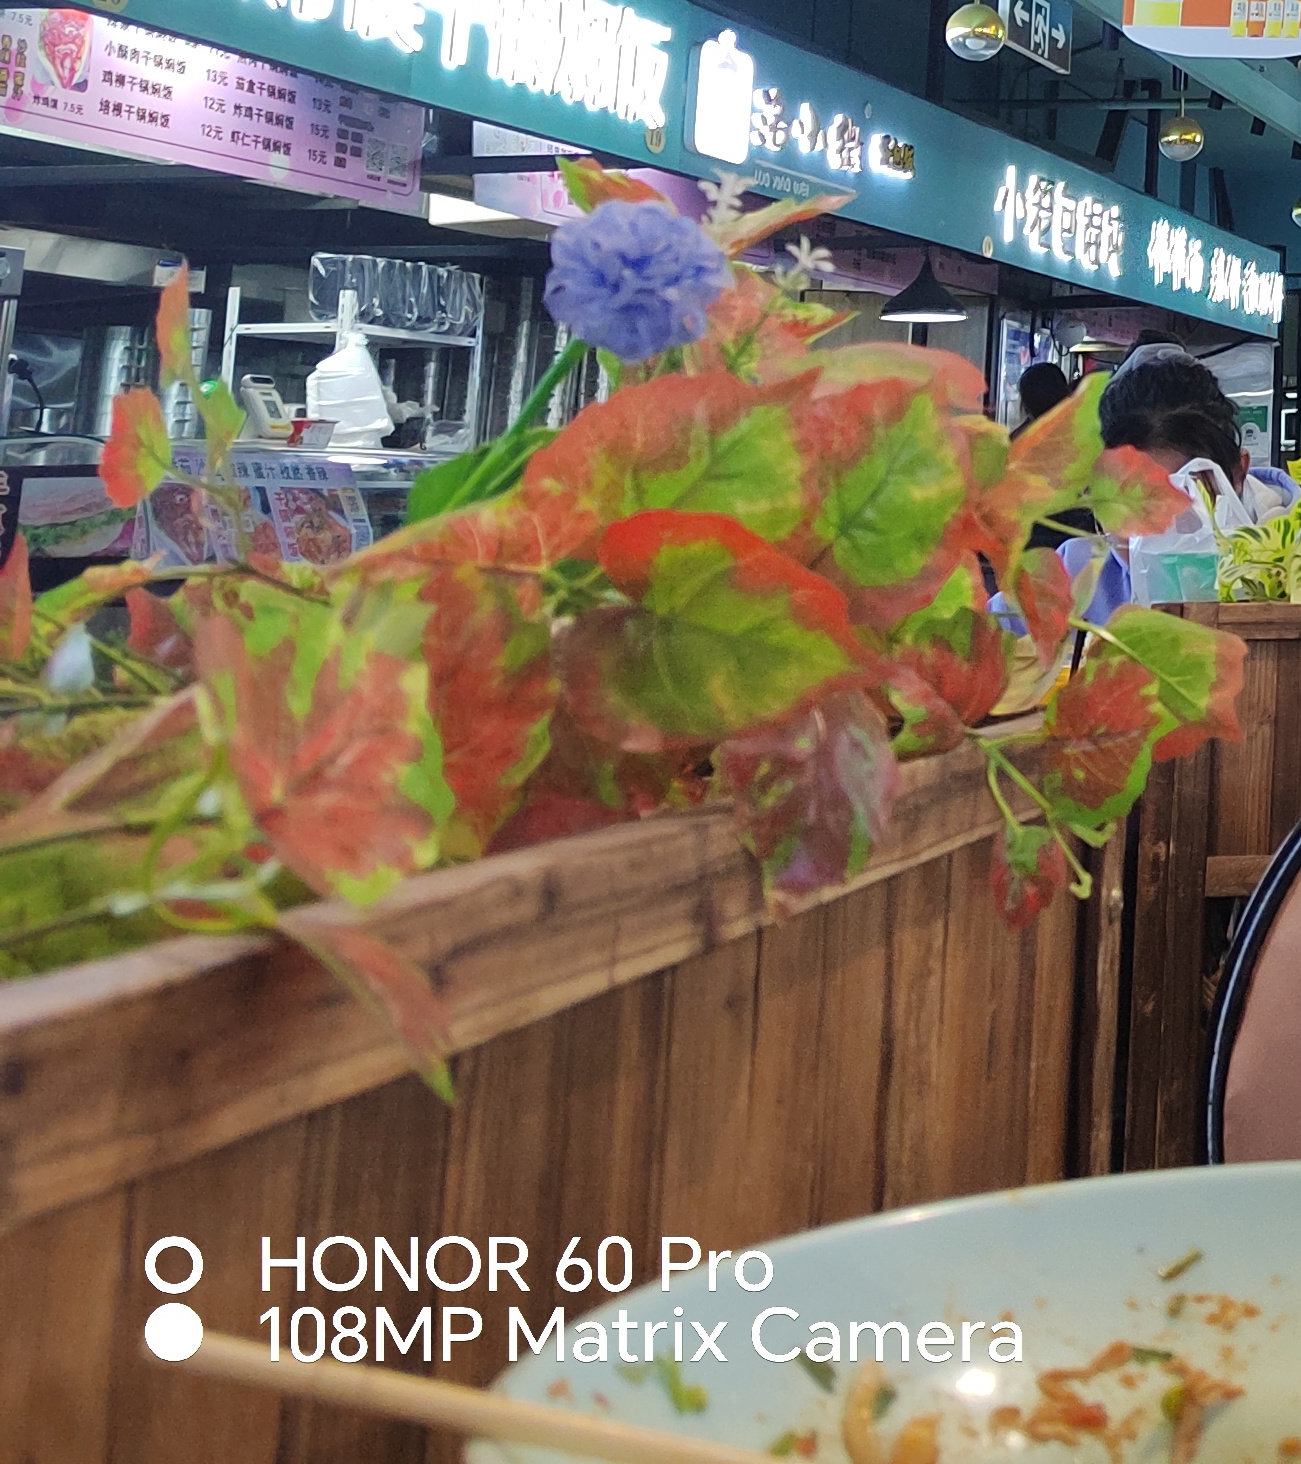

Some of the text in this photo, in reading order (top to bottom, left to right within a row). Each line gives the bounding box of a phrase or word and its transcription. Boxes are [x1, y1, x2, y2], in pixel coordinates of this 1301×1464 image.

[63, 102, 84, 116] 7.5元
[206, 69, 228, 87] 13元
[312, 97, 332, 114] 13元
[99, 98, 327, 165] 培根干锅焖饭 12元 虾仁干锅焖饭 15元
[203, 96, 226, 114] 12元
[233, 103, 294, 131] 炸鸡干锅焖饭
[310, 123, 330, 139] 15元
